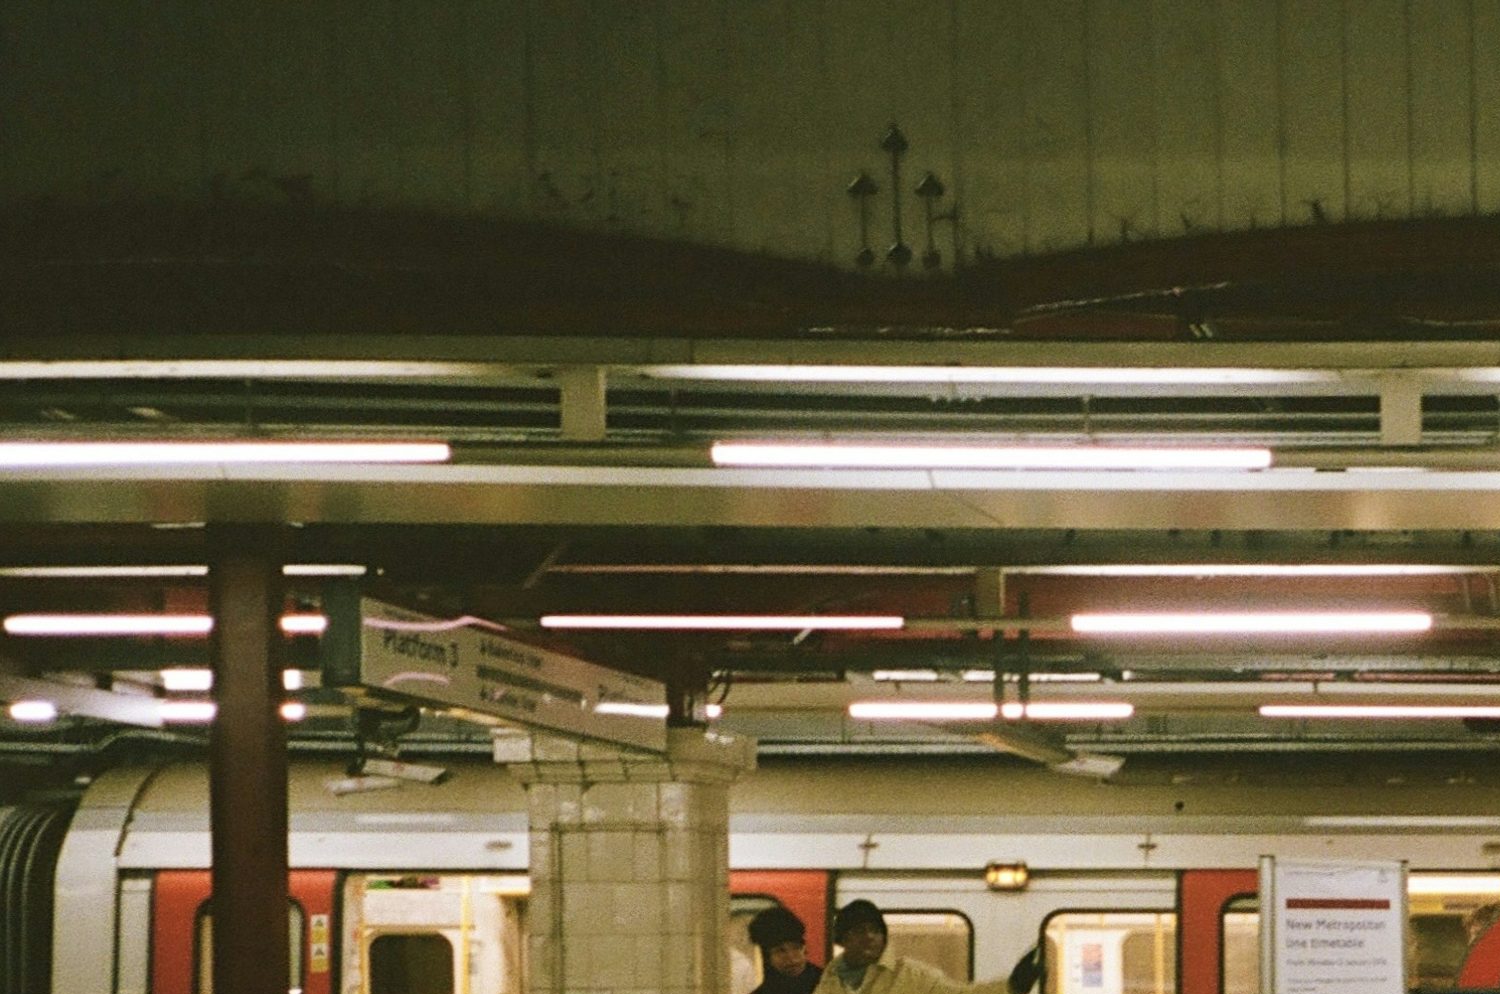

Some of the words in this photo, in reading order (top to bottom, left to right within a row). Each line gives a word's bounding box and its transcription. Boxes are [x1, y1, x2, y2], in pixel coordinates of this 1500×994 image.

[384, 628, 447, 666] Platform
[1286, 919, 1312, 930] New
[1316, 919, 1385, 932] Metropolitan
[1311, 938, 1364, 948] timetable
